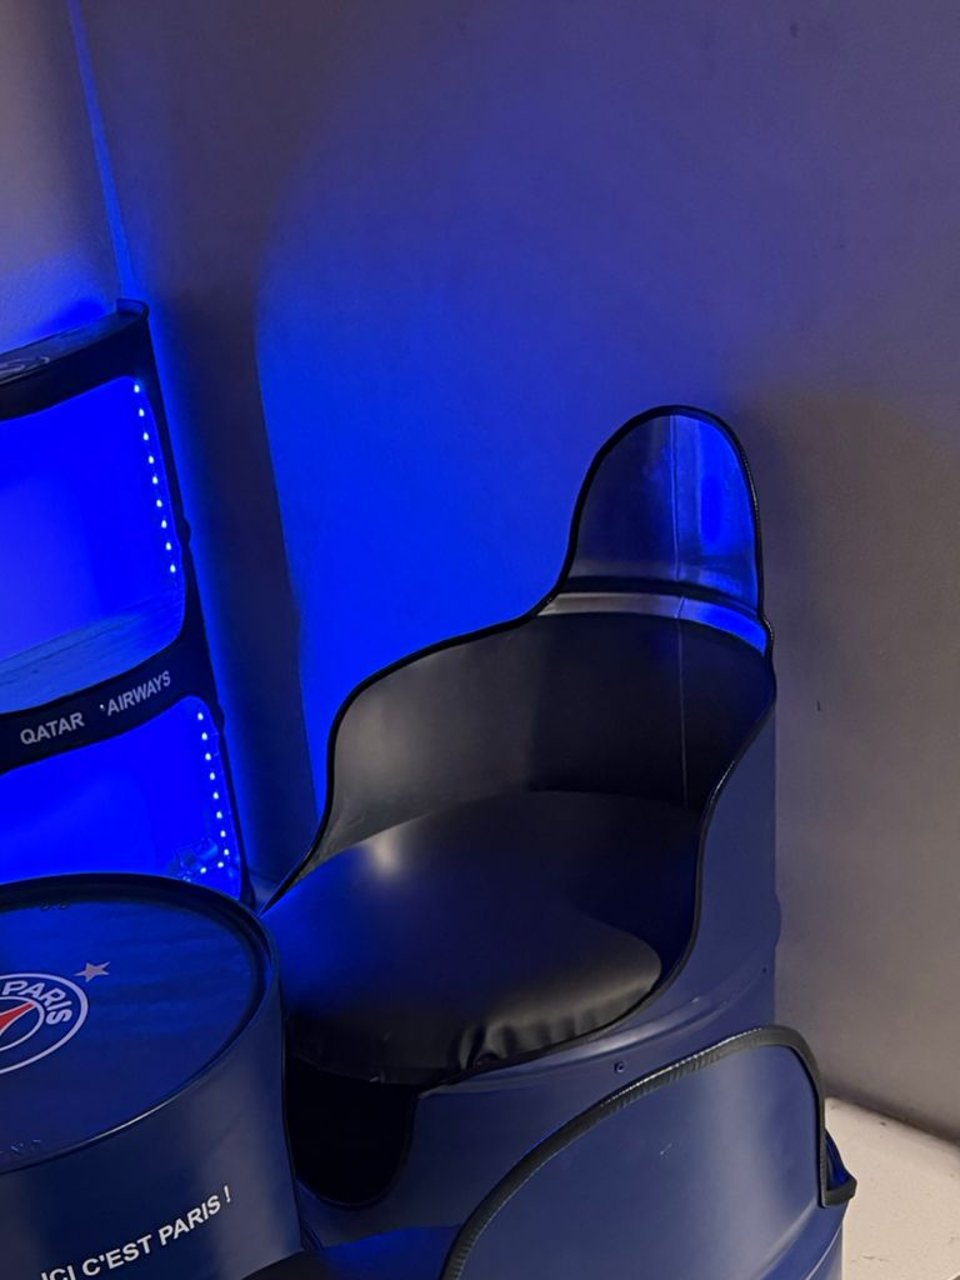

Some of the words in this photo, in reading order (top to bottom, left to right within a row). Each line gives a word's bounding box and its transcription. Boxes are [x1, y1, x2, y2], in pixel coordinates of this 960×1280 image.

[20, 712, 85, 745] QATAR
[107, 670, 171, 716] AIRWAYS
[1, 980, 73, 1025] PARIS
[82, 1234, 153, 1276] C'EST
[158, 1195, 221, 1246] PARIS
